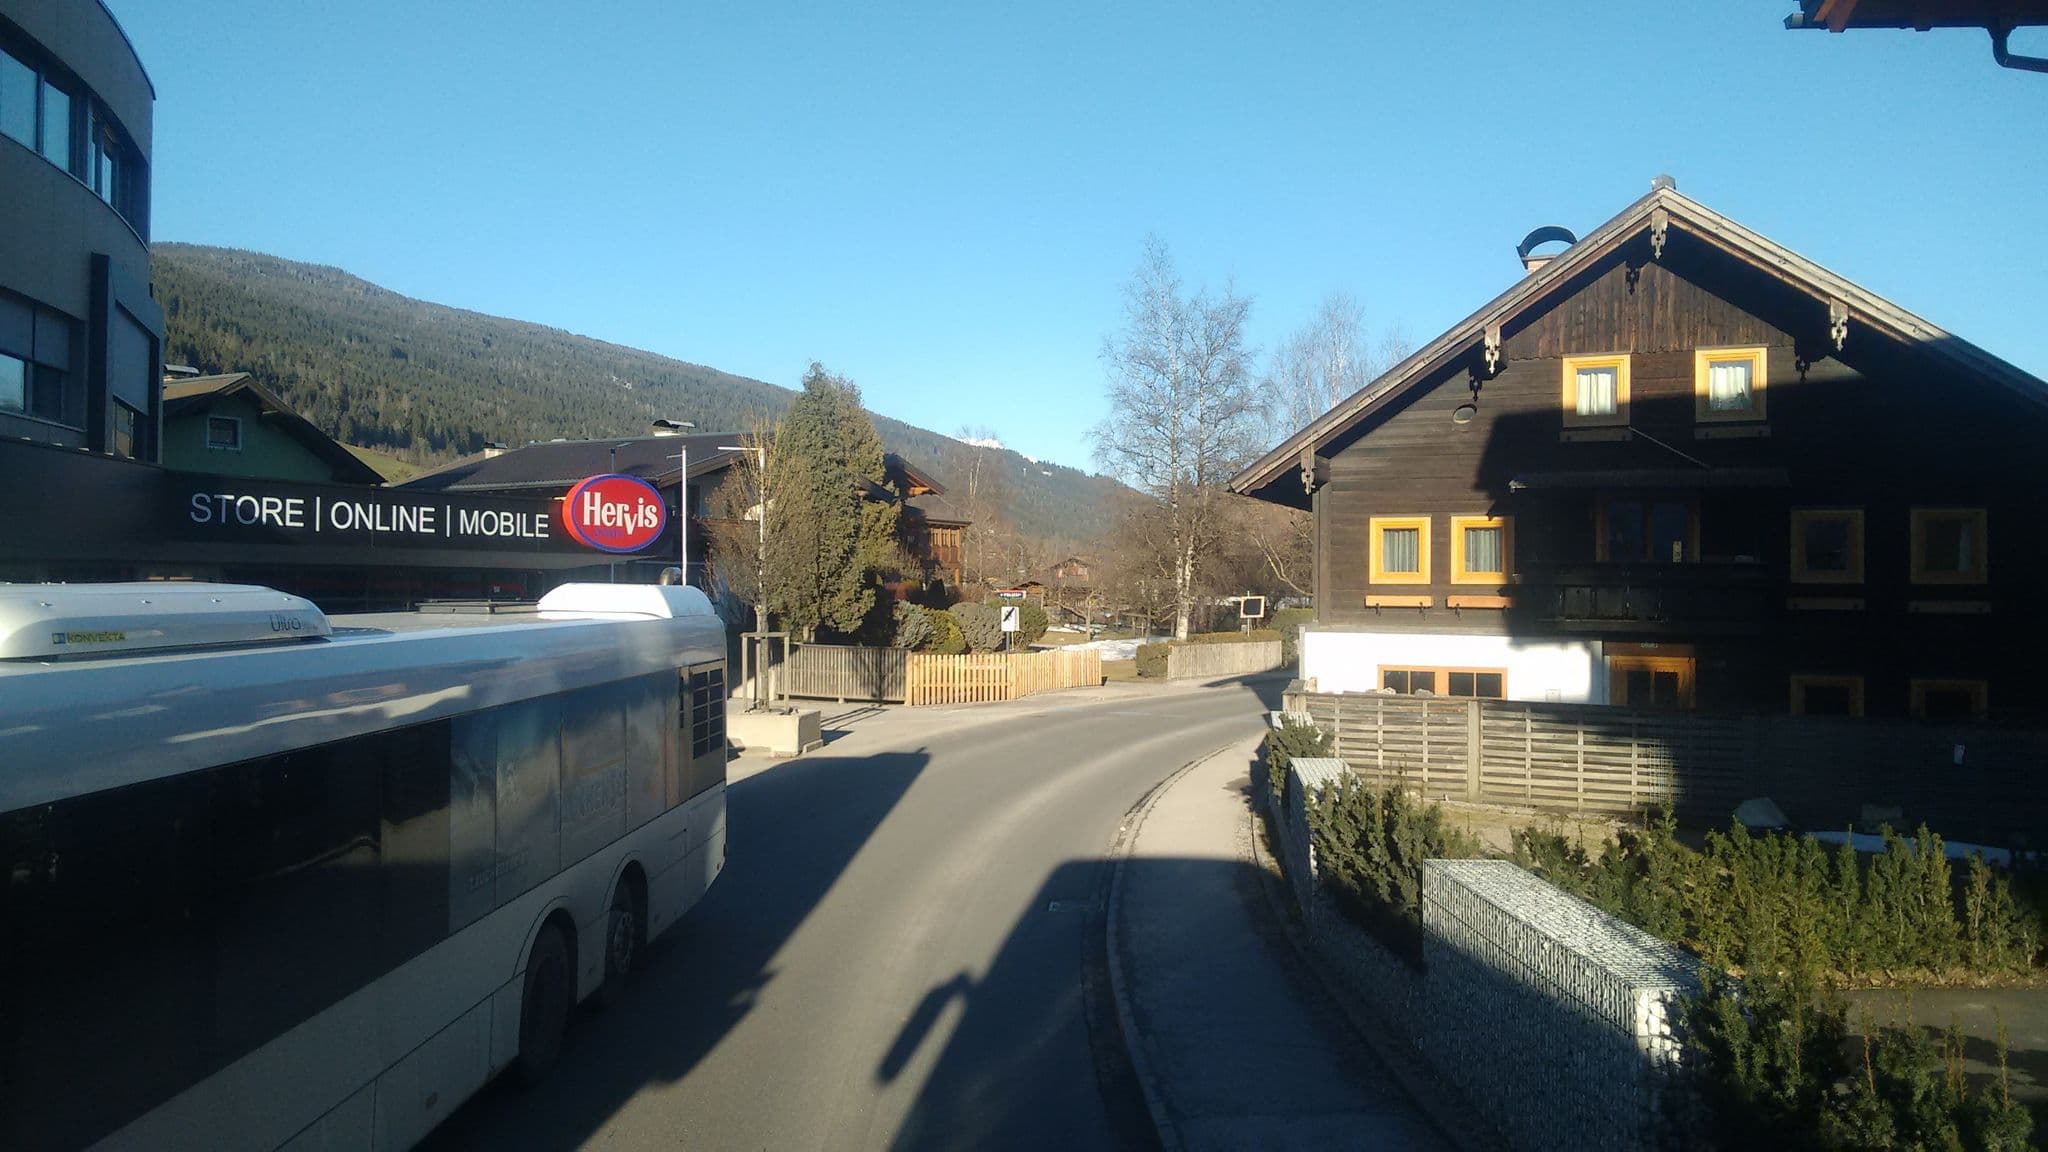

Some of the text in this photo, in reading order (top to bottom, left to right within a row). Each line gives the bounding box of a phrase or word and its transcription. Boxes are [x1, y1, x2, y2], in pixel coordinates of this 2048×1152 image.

[190, 494, 304, 527] STORE
[330, 501, 436, 534] ONLINE
[460, 510, 550, 538] MOBILE
[583, 490, 659, 535] Hervis
